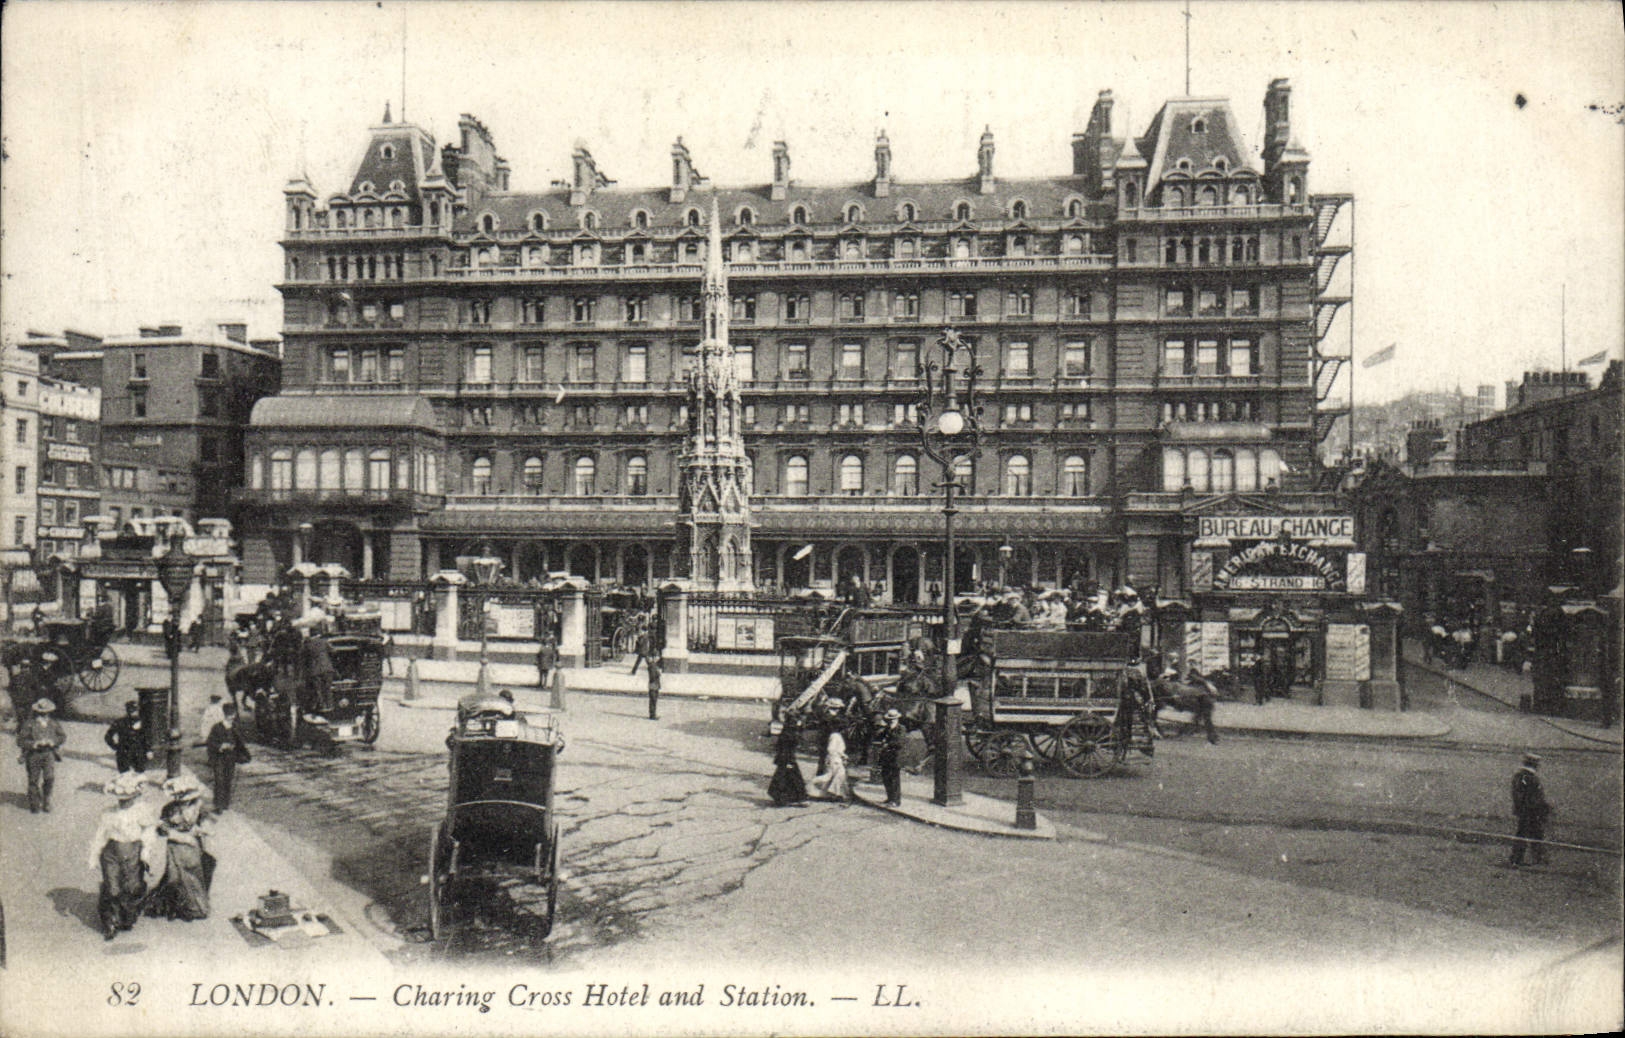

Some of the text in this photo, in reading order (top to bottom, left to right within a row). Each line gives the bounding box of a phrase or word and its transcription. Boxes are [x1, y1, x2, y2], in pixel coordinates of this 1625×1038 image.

[1201, 518, 1353, 537] BUREAU CHANGE
[1279, 543, 1344, 590] EXCHANGE
[1250, 577, 1304, 588] STRAND
